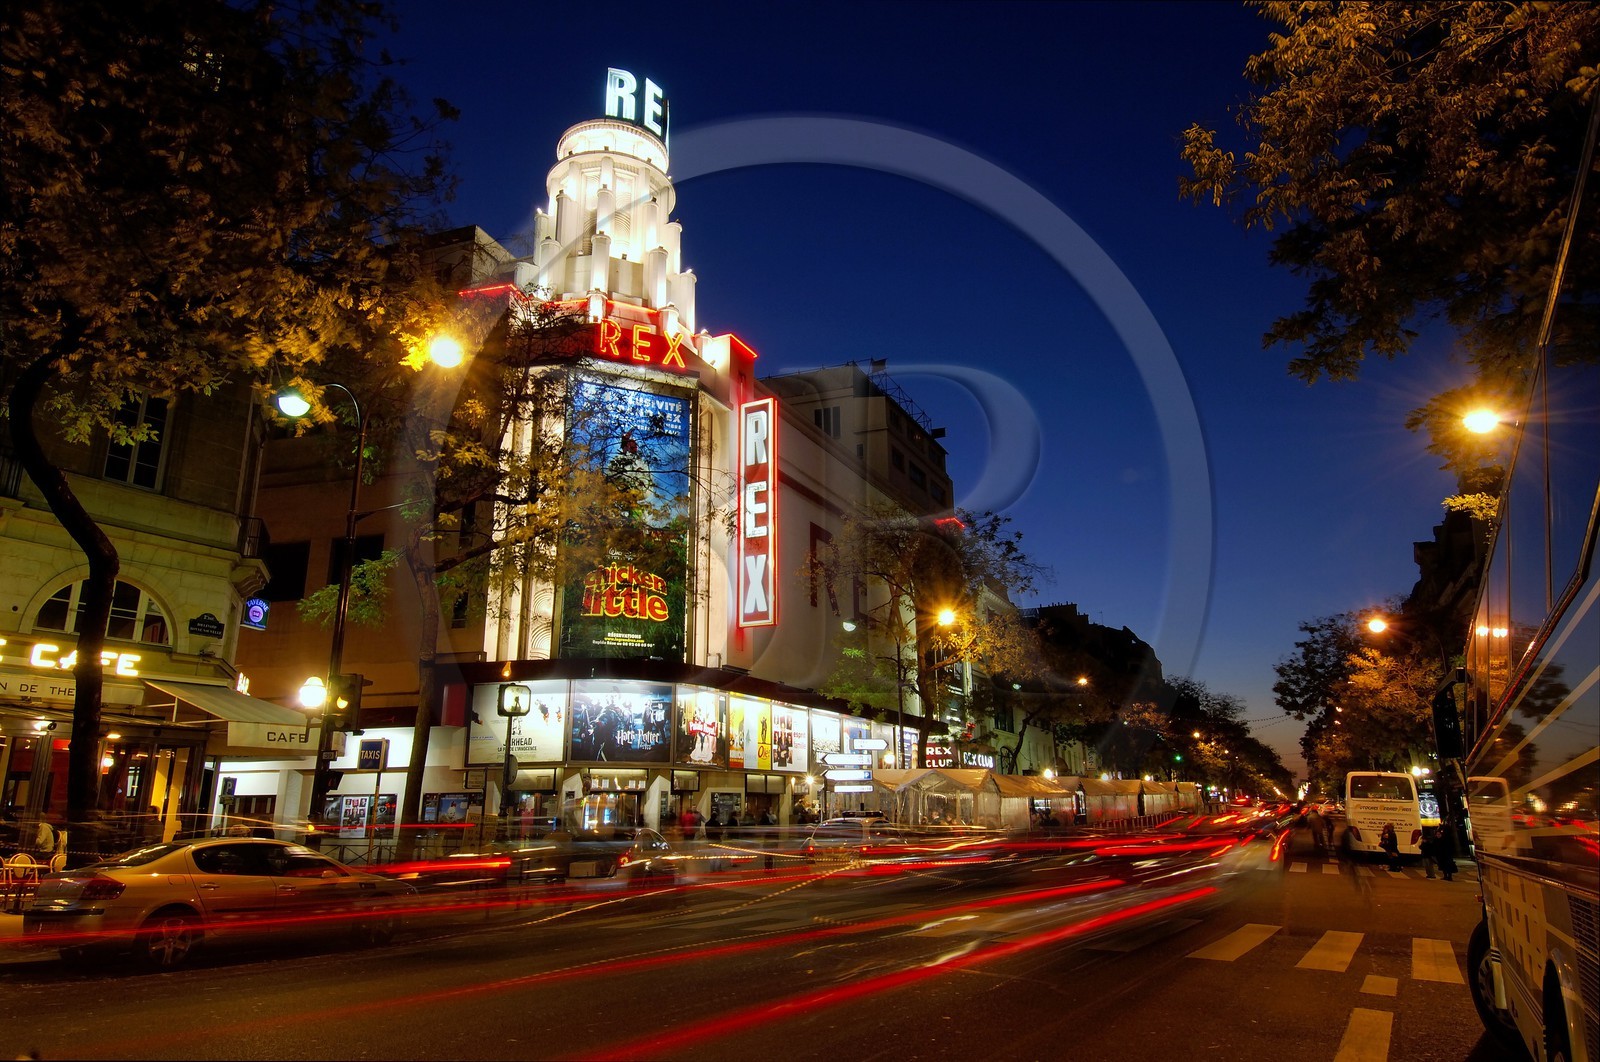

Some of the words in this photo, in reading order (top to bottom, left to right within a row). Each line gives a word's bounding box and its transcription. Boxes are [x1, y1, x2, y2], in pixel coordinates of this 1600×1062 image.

[605, 67, 669, 140] RE
[600, 318, 686, 368] REX
[744, 410, 768, 614] REX
[584, 562, 667, 595] chicken
[581, 583, 669, 622] little
[20, 683, 39, 693] DE
[49, 686, 75, 696] THE
[503, 738, 532, 746] RHEAD
[615, 729, 635, 746] Harry
[637, 728, 660, 748] Potter
[361, 750, 380, 760] TAXIS
[926, 746, 952, 755] REX
[977, 754, 993, 768] CLUB
